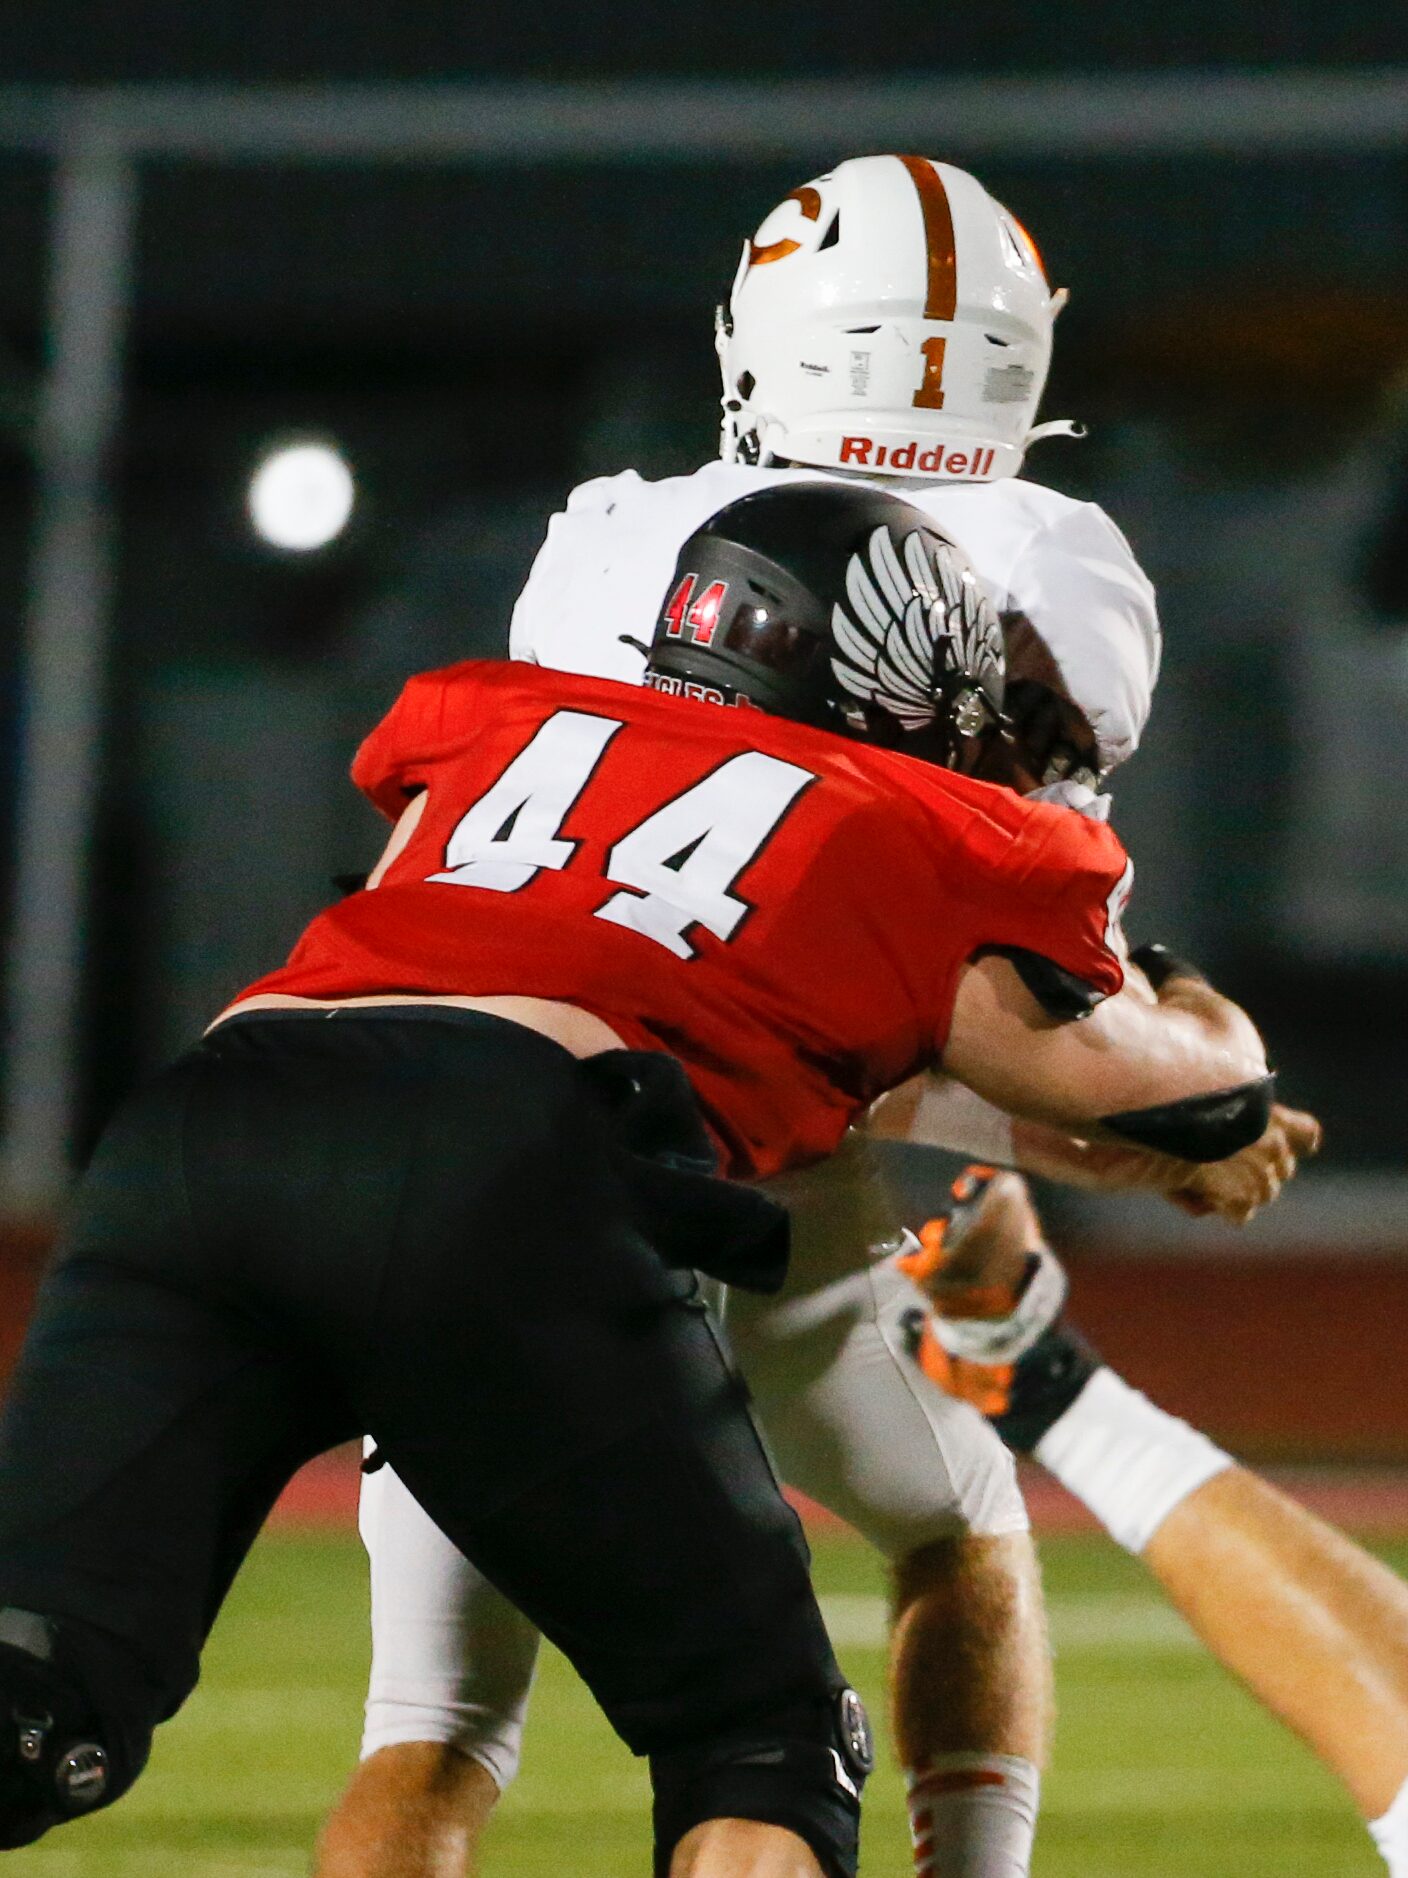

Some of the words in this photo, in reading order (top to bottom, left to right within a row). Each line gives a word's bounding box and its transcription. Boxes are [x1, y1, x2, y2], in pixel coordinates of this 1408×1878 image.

[912, 337, 947, 410] 1
[839, 436, 995, 475] Riddell
[664, 572, 729, 648] 44
[424, 709, 820, 960] 44
